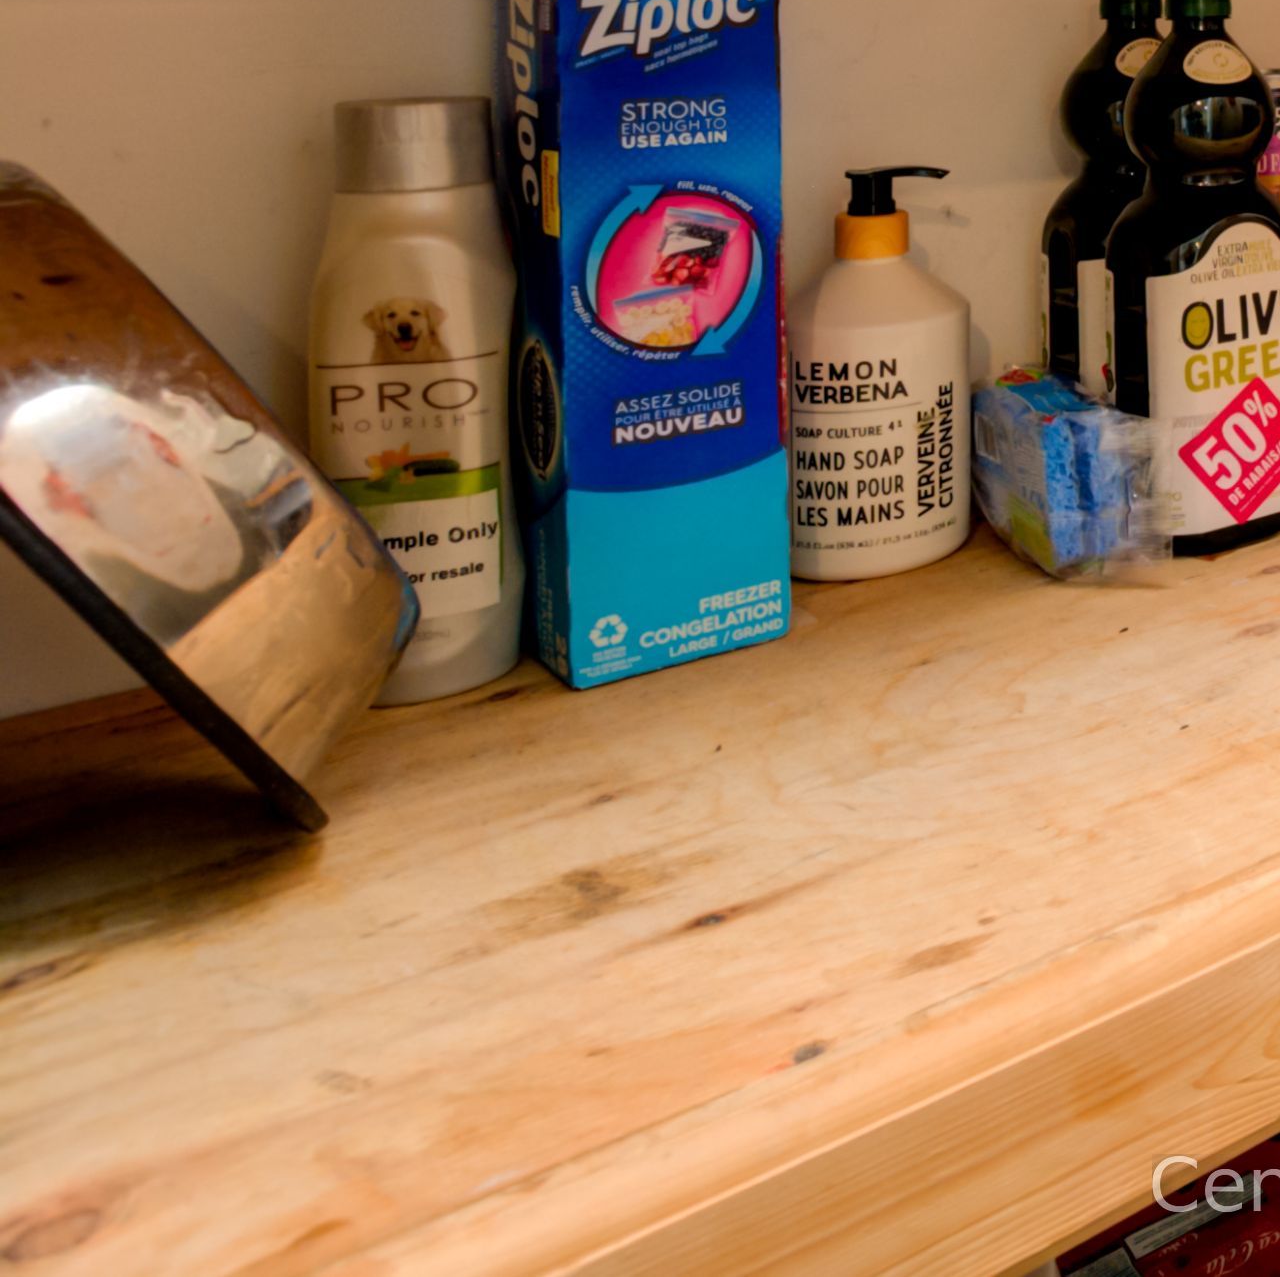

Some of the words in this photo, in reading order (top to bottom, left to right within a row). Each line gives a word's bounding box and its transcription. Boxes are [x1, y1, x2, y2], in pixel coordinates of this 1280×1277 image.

[622, 99, 726, 122] STRONG
[621, 118, 700, 135] ENOUGH
[705, 117, 727, 130] TO
[621, 133, 661, 149] USE
[664, 130, 728, 147] AGAIN
[1217, 241, 1249, 257] EXTRA
[1190, 269, 1218, 284] OLIVE
[795, 358, 898, 382] LEMON
[330, 377, 478, 416] PRO
[615, 393, 672, 415] ASSEZ
[678, 382, 742, 404] SOLIDE
[795, 380, 909, 405] VERBENA
[331, 413, 466, 435] NOURISH
[615, 411, 652, 426] POUR
[615, 406, 743, 445] NOUVEAU
[795, 426, 822, 439] SOAP
[827, 425, 883, 439] CULTURE
[1192, 390, 1278, 491] 50%
[936, 381, 953, 509] CITRONNÉE
[796, 450, 846, 472] HAND
[853, 446, 905, 470] SOAP
[917, 407, 936, 518] VERVEINE
[796, 479, 848, 501] SAVON
[857, 475, 905, 499] POUR
[1228, 486, 1246, 507] DE
[796, 505, 828, 527] LES
[837, 500, 905, 527] MAINS
[448, 520, 498, 544] Only
[431, 560, 485, 581] resale
[699, 579, 782, 615] FREEZER
[639, 599, 782, 649] CONGELATION
[668, 636, 717, 658] LARGE
[731, 618, 784, 643] GRAND
